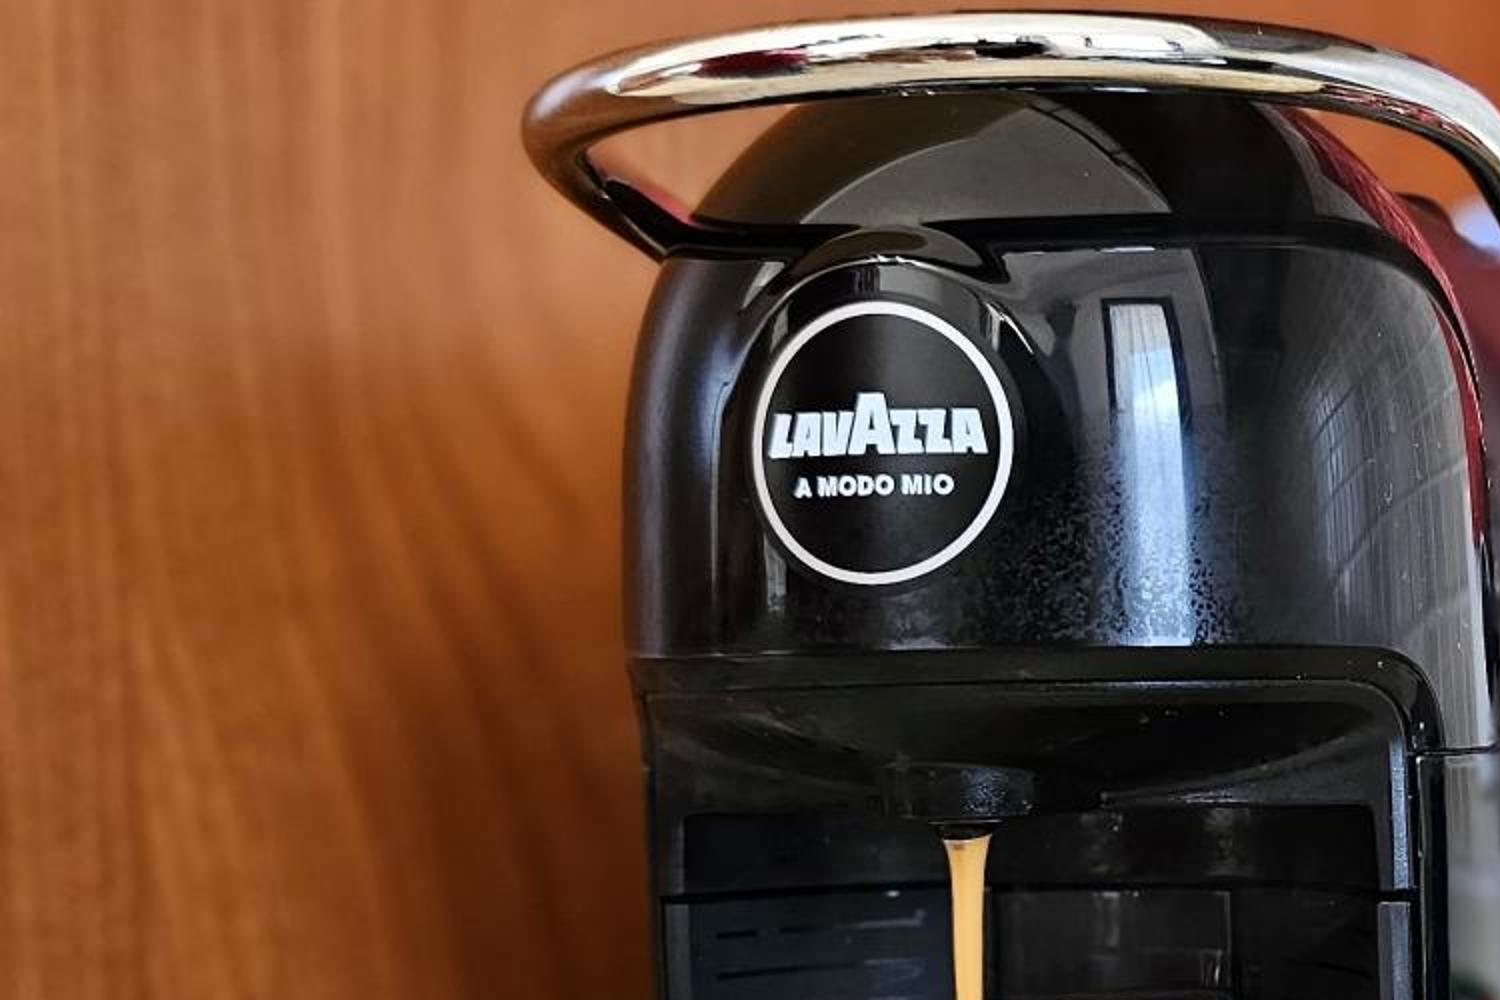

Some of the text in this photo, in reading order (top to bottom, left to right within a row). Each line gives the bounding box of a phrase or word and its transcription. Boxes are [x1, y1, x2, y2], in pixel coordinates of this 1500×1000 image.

[768, 392, 989, 459] LAVAZZA
[794, 474, 954, 498] A MODO MIO
